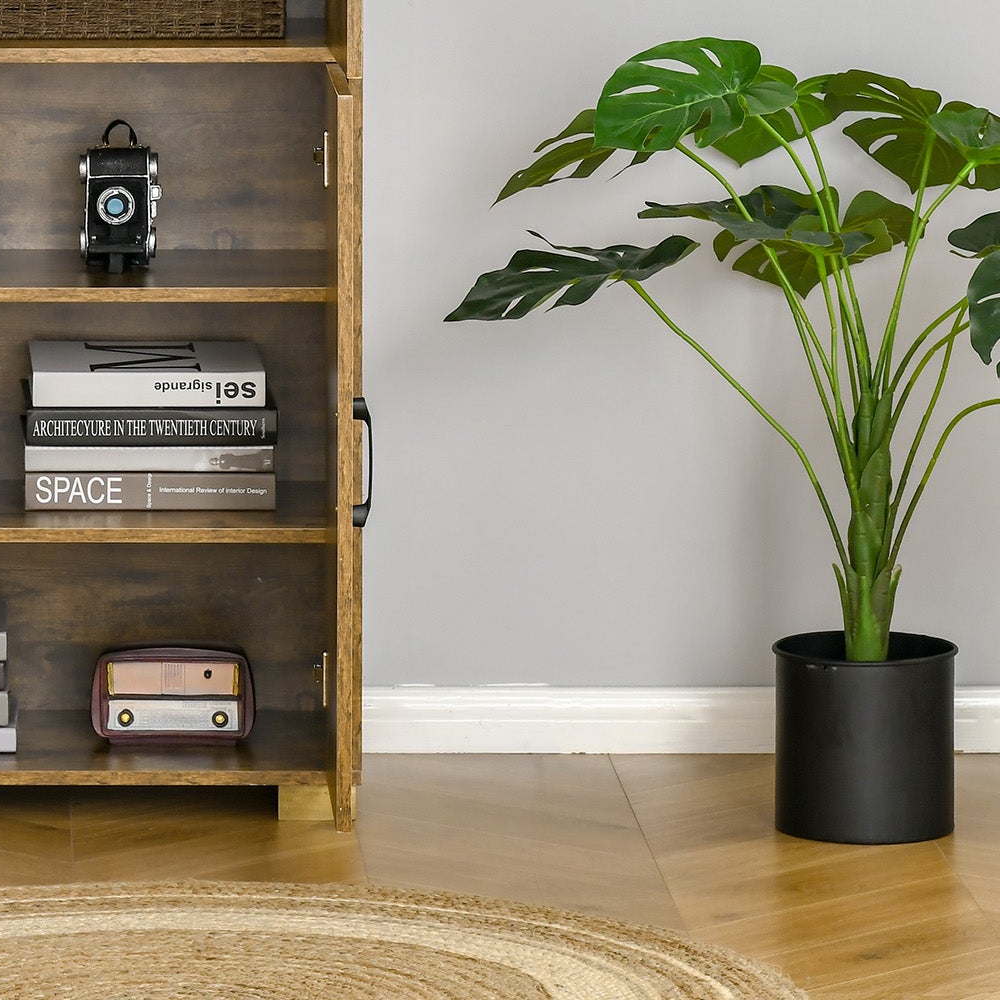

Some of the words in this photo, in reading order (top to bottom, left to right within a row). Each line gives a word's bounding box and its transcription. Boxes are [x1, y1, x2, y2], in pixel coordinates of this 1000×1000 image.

[154, 378, 212, 393] sigrande
[215, 381, 257, 405] sei
[32, 419, 112, 437] ARCHITECYURE
[113, 420, 125, 437] IN
[125, 419, 147, 437] THE
[148, 419, 209, 437] TWENTIETH
[209, 419, 258, 437] CENTURY
[35, 475, 123, 504] SPACE
[195, 486, 217, 494] Review
[218, 486, 225, 494] of
[247, 487, 268, 495] Design
